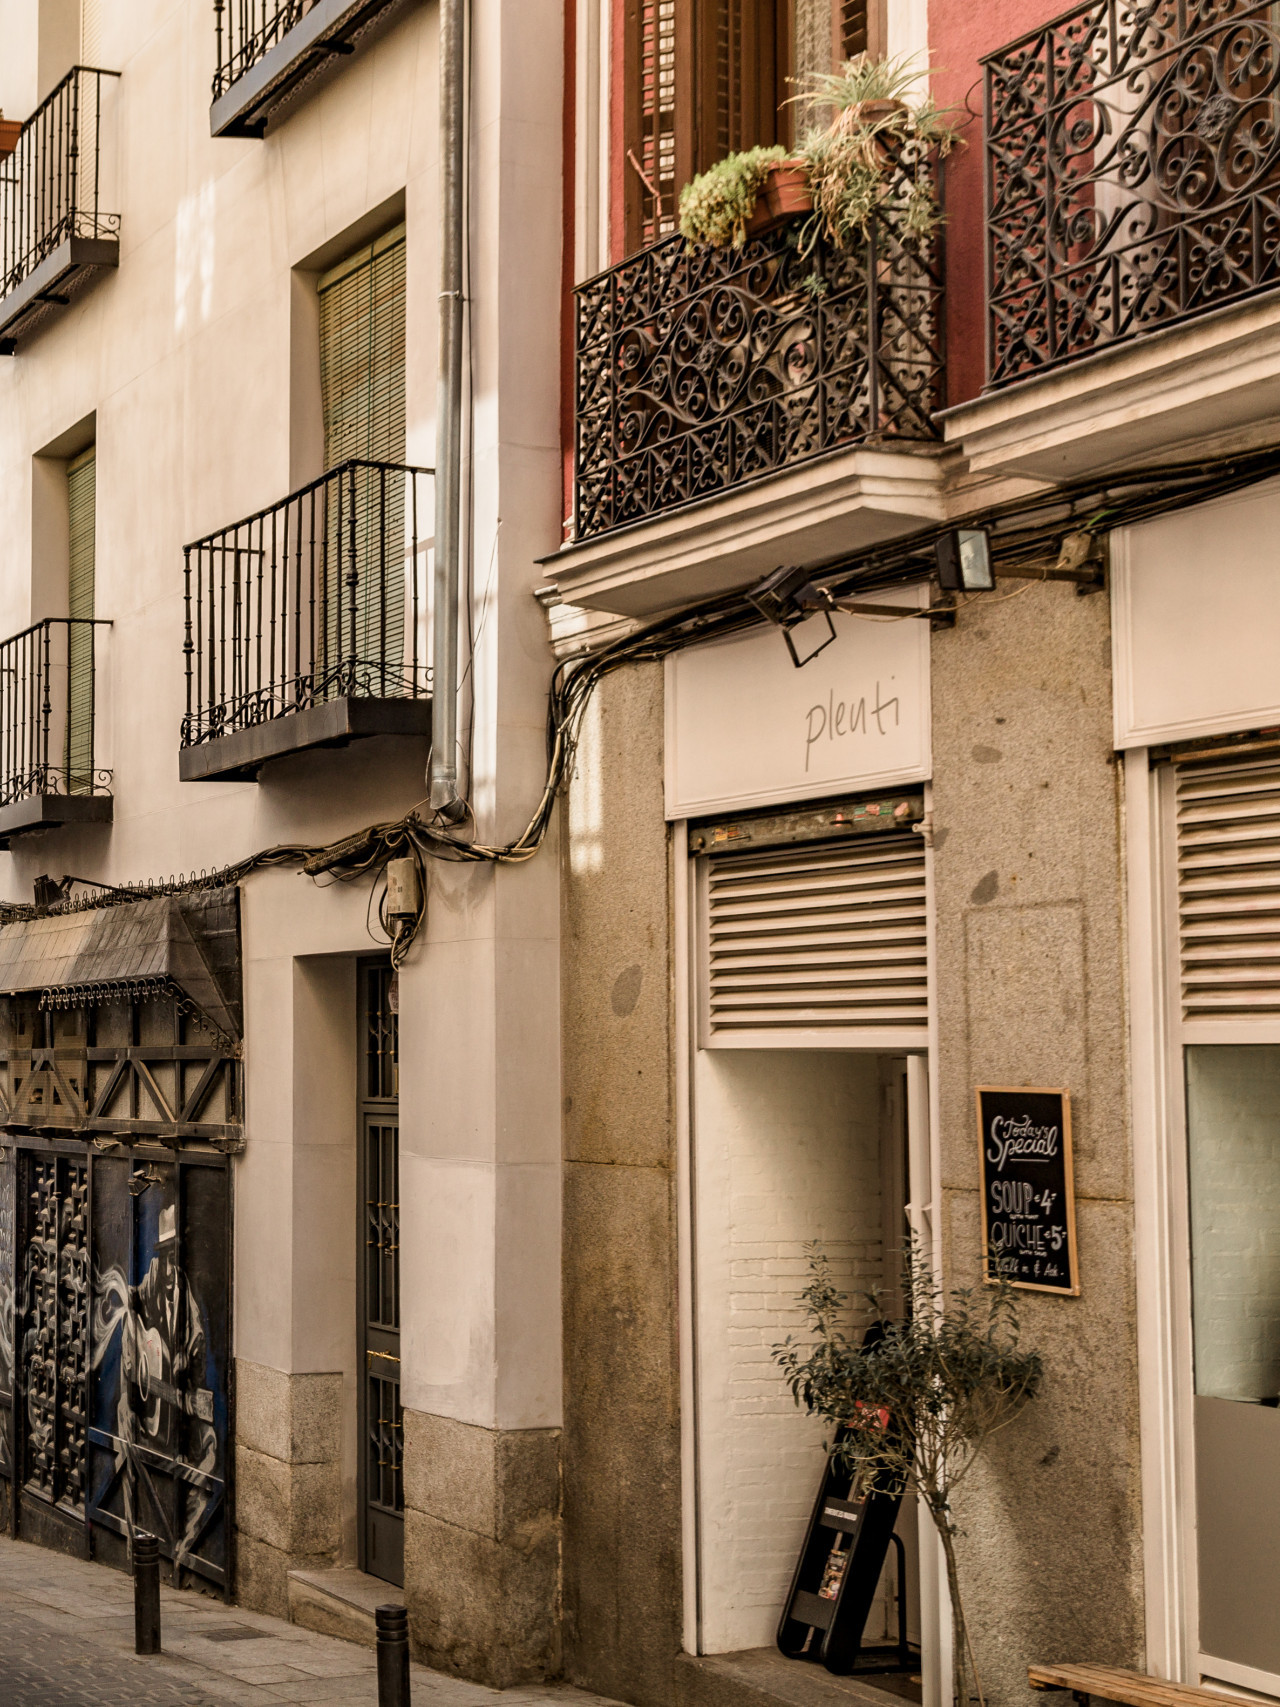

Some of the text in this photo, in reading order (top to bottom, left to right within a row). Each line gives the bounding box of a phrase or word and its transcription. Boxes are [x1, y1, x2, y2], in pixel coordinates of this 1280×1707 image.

[805, 675, 899, 772] plenti
[987, 1115, 1058, 1172] Special
[1003, 1114, 1050, 1139] Today's
[991, 1180, 1033, 1214] SOUP
